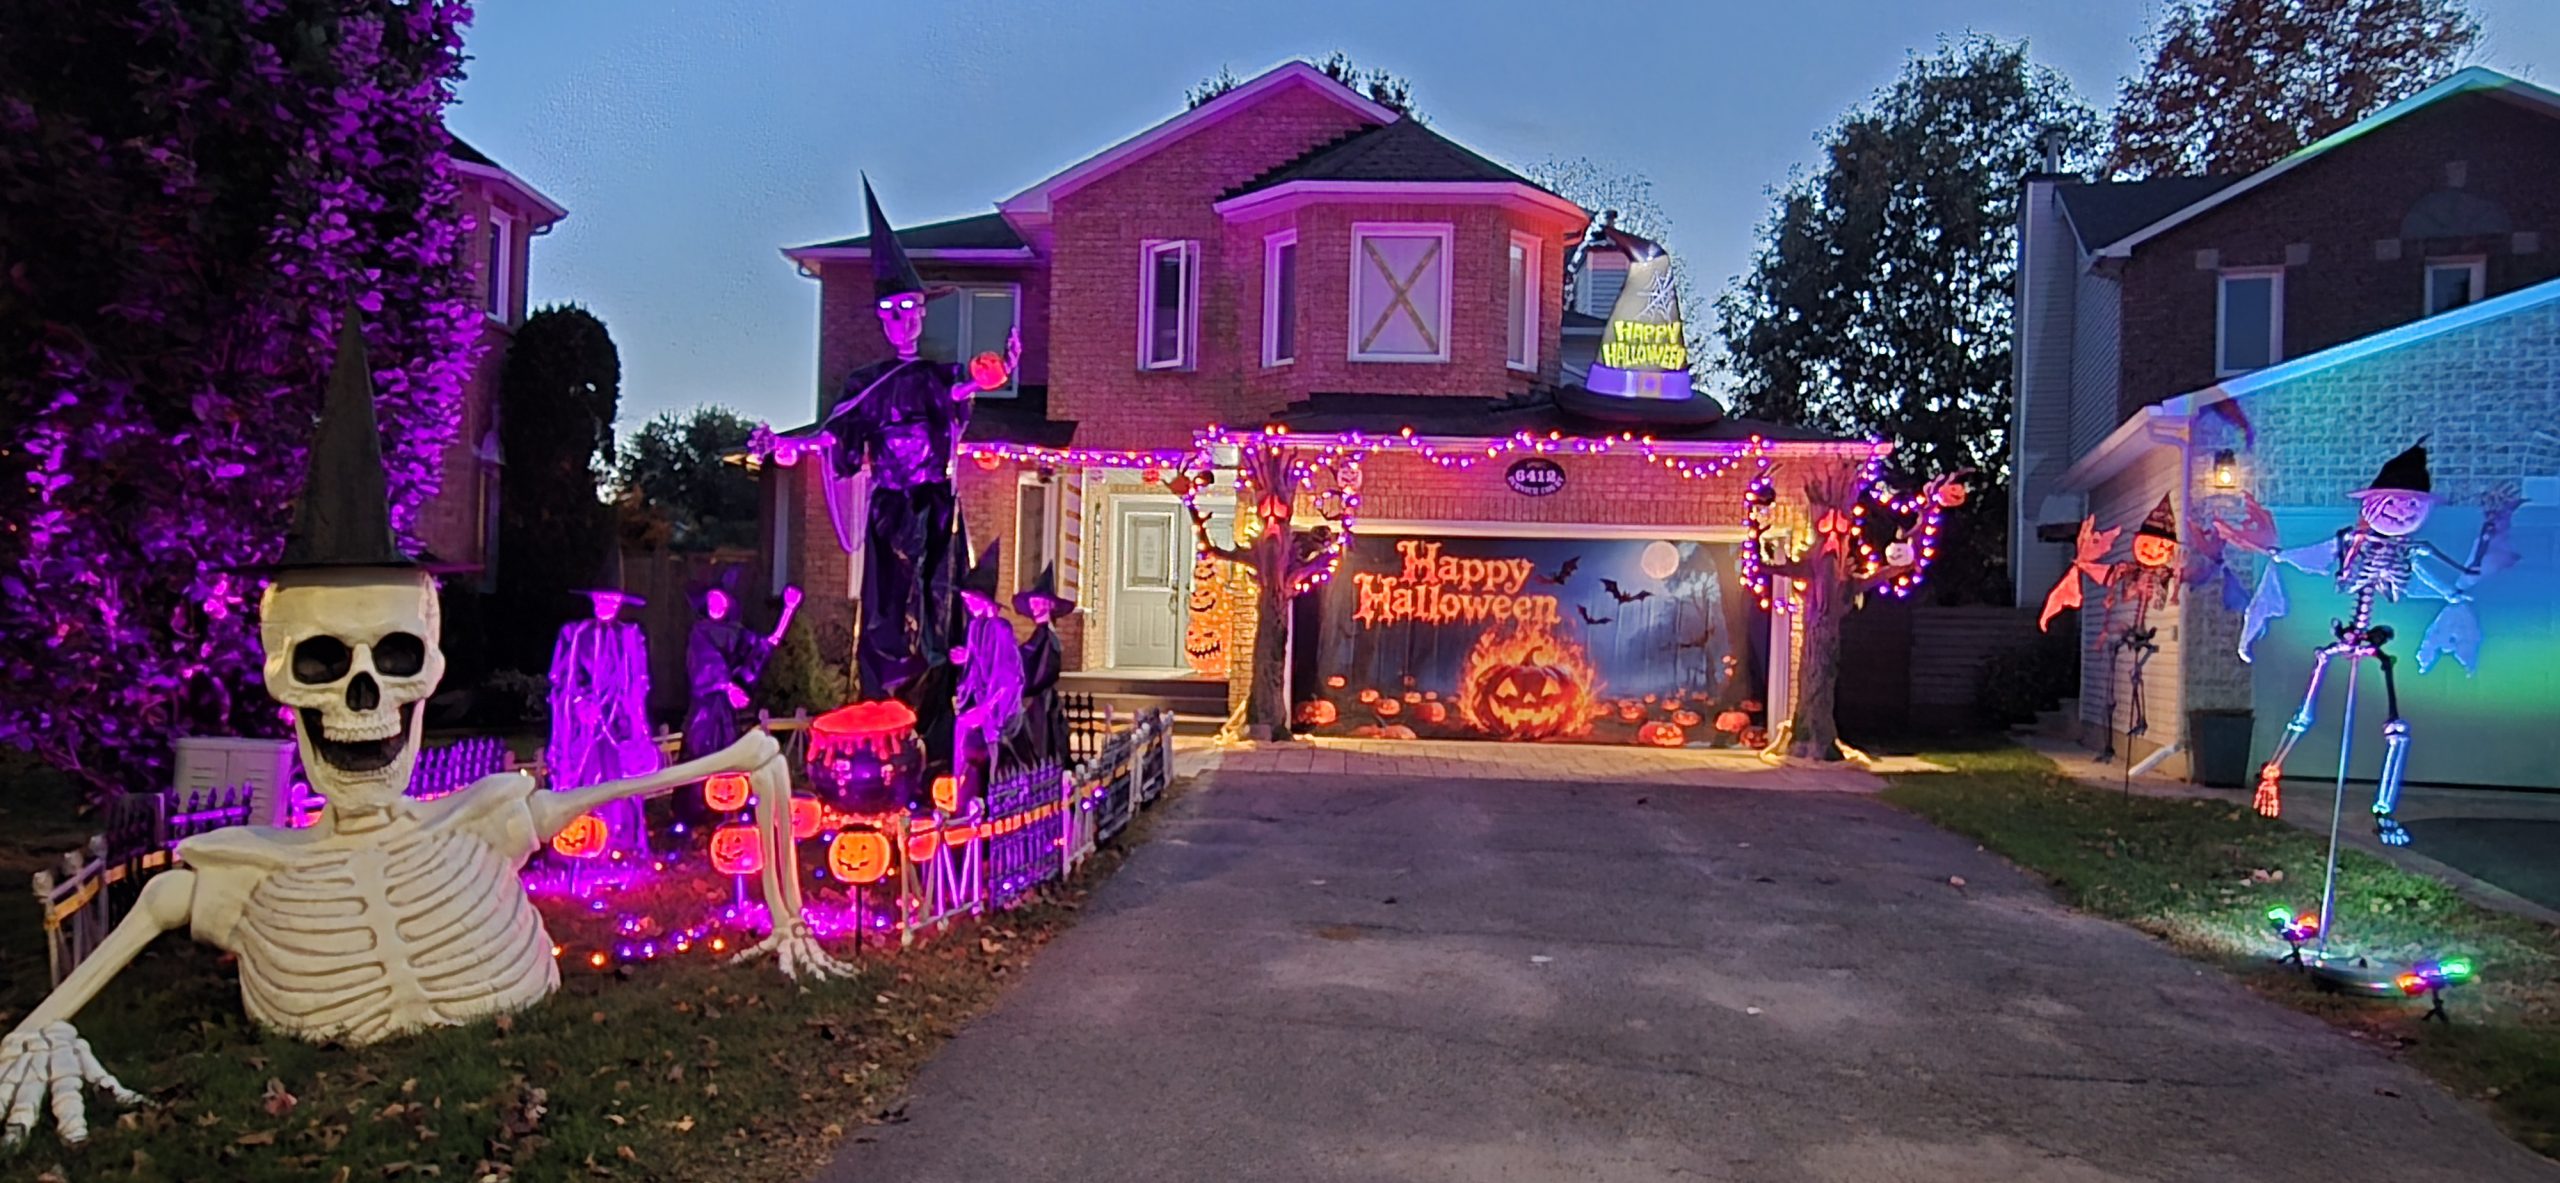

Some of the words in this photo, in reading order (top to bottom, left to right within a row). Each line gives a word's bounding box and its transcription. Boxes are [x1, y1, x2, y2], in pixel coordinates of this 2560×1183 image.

[1614, 320, 1681, 344] HAPPY
[1602, 342, 1686, 371] HALLOWEEN
[1515, 469, 1556, 483] 6412
[1396, 540, 1535, 594] Happy
[1352, 572, 1562, 630] Halloween
